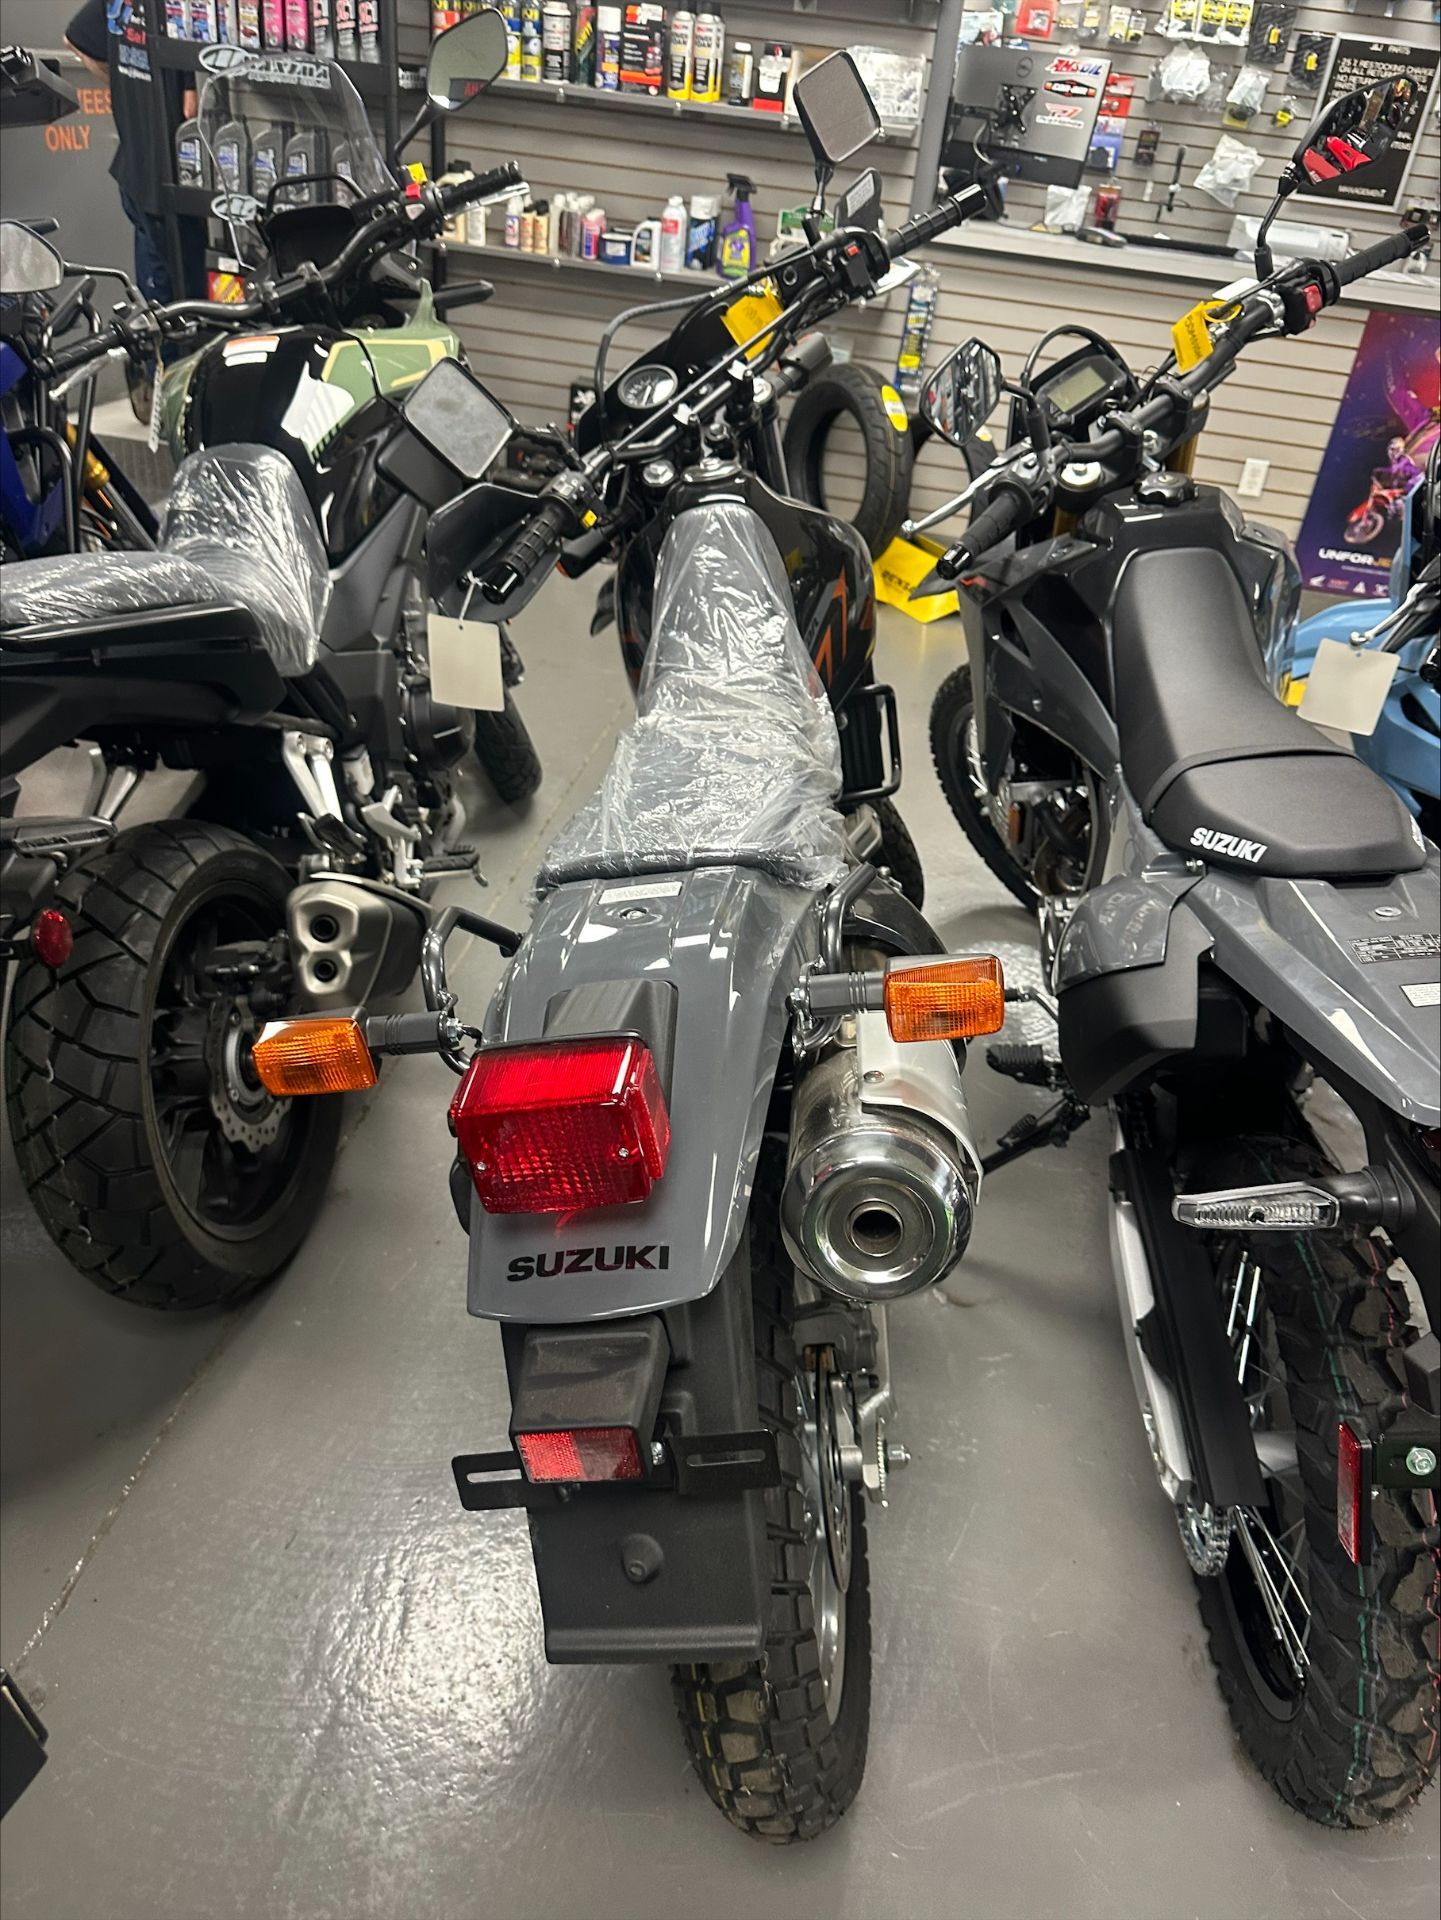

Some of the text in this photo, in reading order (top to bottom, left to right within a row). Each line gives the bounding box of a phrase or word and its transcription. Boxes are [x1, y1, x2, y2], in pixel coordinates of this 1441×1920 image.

[45, 125, 90, 151] ONLY
[1190, 827, 1268, 863] SUZUKI
[506, 1245, 670, 1282] SUZUKI
